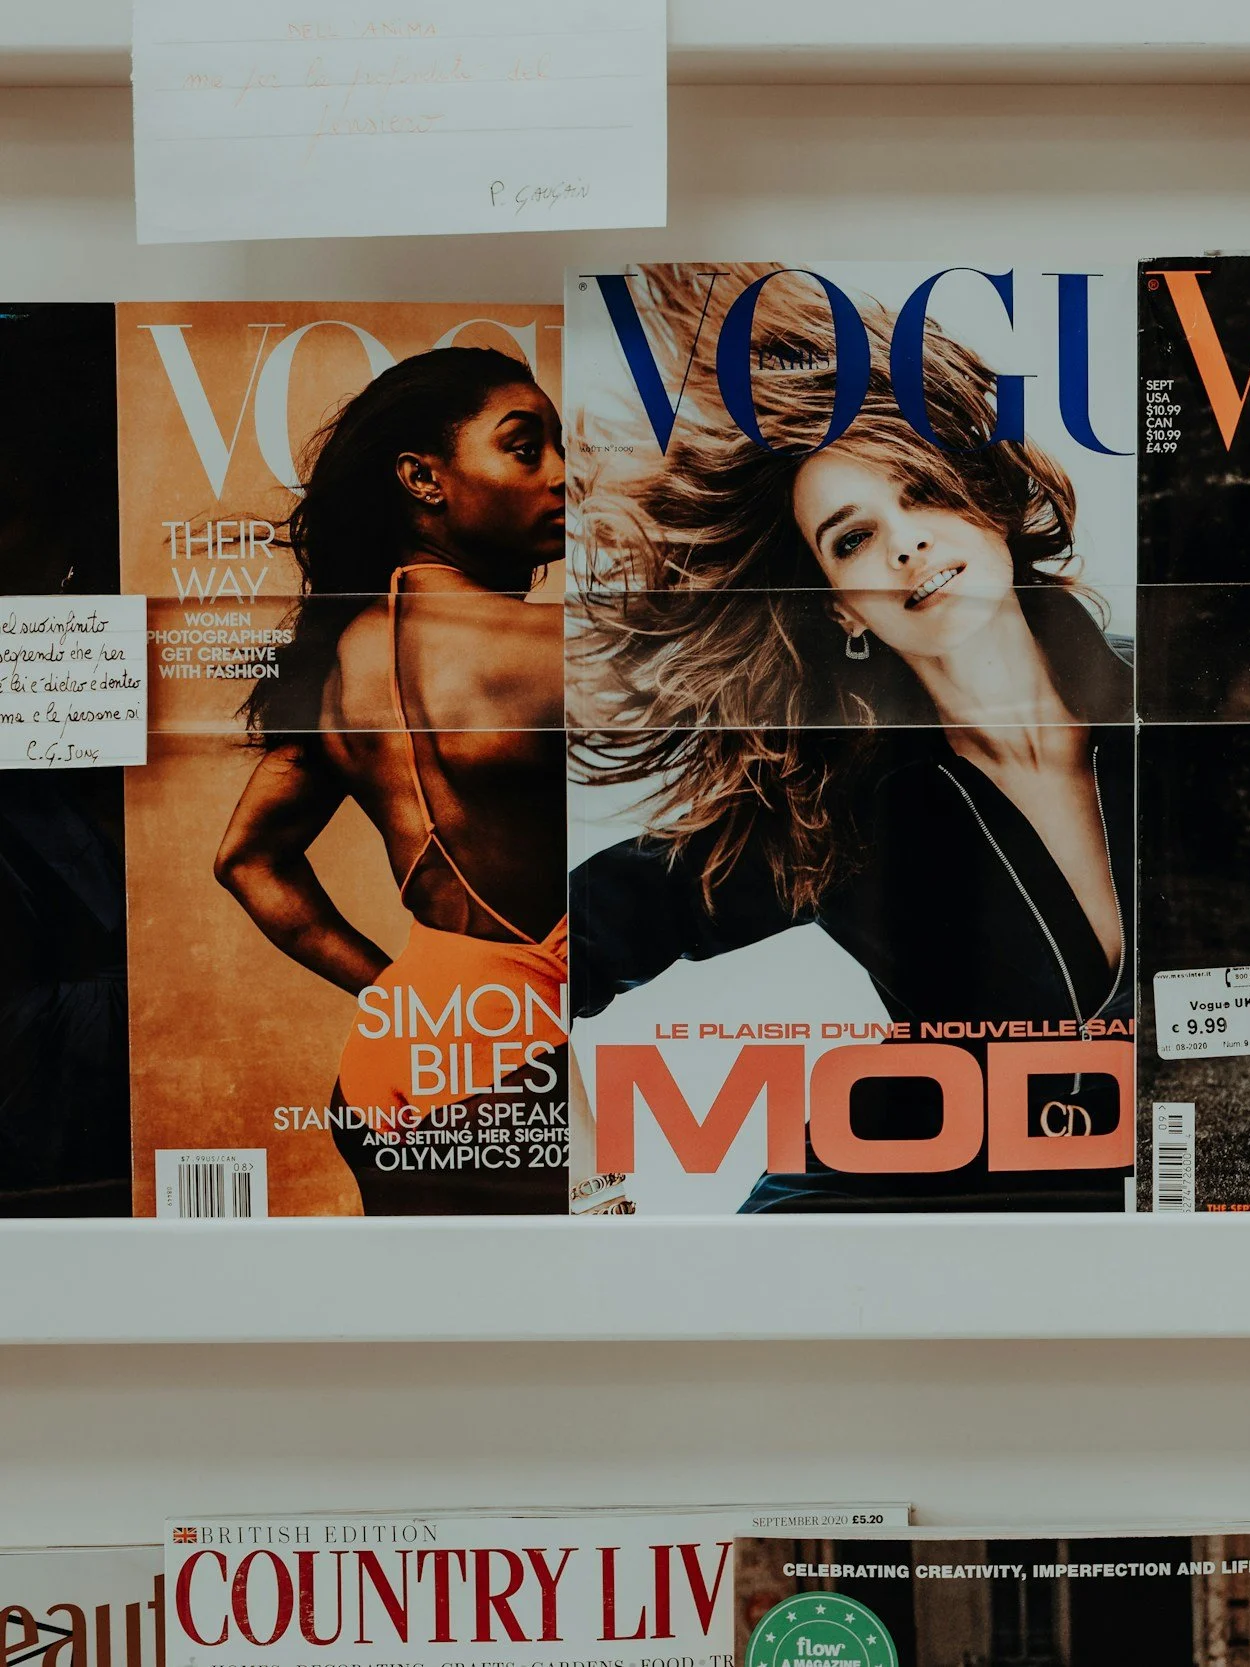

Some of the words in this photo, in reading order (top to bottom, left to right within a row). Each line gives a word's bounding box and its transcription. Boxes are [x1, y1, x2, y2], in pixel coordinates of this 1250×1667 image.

[1146, 380, 1174, 391] SEPT
[1146, 392, 1171, 403] USA
[1146, 404, 1181, 417] $10.99
[1146, 417, 1173, 428] CAN
[1146, 428, 1181, 442] $10.99
[1146, 442, 1178, 453] £4.99
[161, 520, 275, 560] THEIR
[172, 566, 269, 605] WAY
[184, 612, 251, 627] WOMEN
[161, 647, 193, 662] GET
[197, 646, 276, 662] CREATIVE
[158, 664, 201, 680] WITH
[206, 663, 280, 679] FASHION
[356, 983, 568, 1040] SIMON
[1190, 1000, 1230, 1012] Vogue
[655, 1023, 689, 1039] LE
[698, 1023, 811, 1039] PLAISIR
[921, 1020, 1077, 1039] NOUVELLE
[1172, 1024, 1180, 1033] €
[1187, 1017, 1228, 1035] 9.99
[410, 1040, 558, 1096] BILES
[595, 1041, 1135, 1174] MOD
[273, 1105, 422, 1131] STANDING
[430, 1104, 471, 1131] UP,
[362, 1131, 401, 1147] AND
[405, 1130, 473, 1146] SETTING
[477, 1129, 510, 1144] HER
[375, 1144, 521, 1172] OLYMPICS
[1207, 1203, 1227, 1212] THE
[752, 1515, 819, 1528] SEPTEMBER
[821, 1514, 849, 1527] 2020
[851, 1514, 884, 1525] £5.20
[200, 1525, 311, 1544] BRITISH
[325, 1524, 439, 1543] EDITION
[782, 1563, 910, 1579] CELEBRATING
[915, 1563, 1027, 1581] CREATIVITY,
[1032, 1562, 1171, 1578] IMPERFECTION
[1176, 1561, 1215, 1576] AND
[176, 1546, 579, 1647] COUNTRY
[795, 1636, 846, 1657] flow
